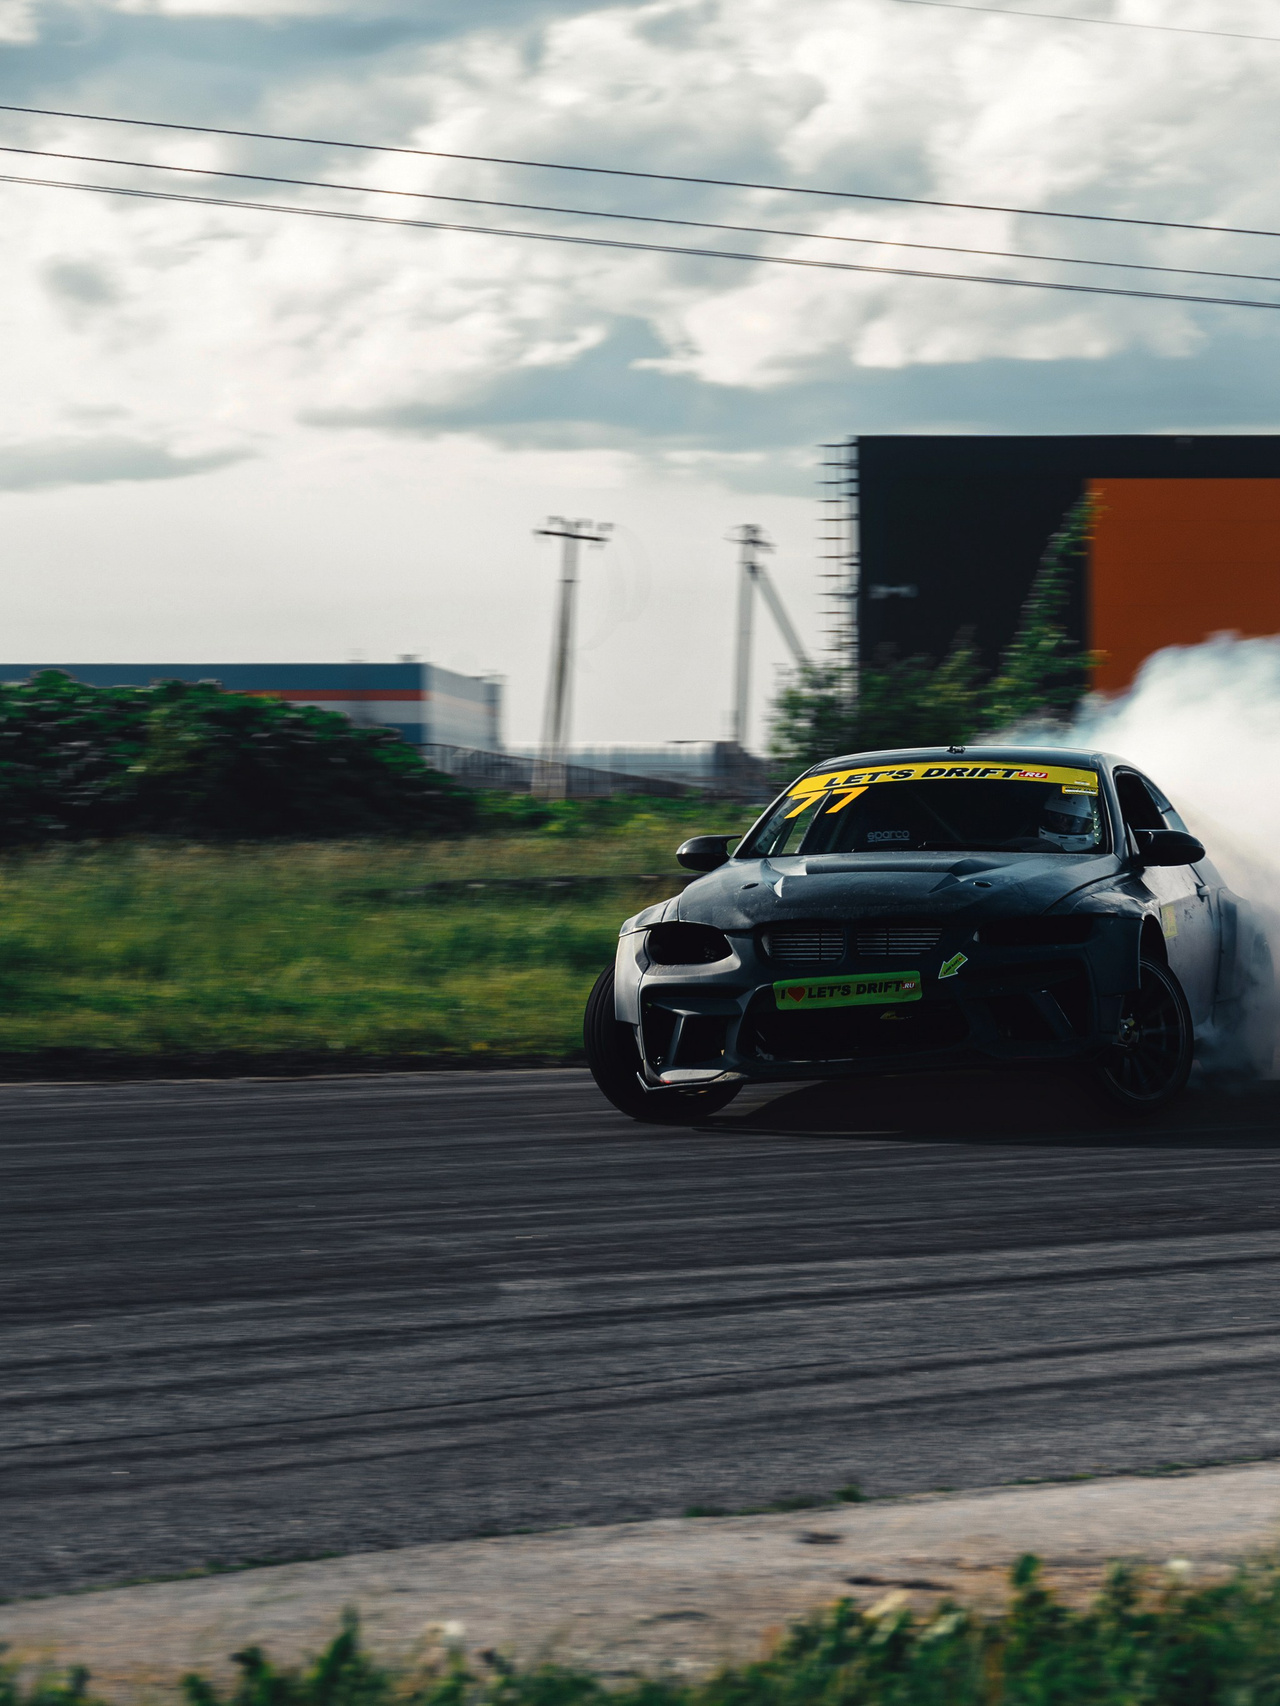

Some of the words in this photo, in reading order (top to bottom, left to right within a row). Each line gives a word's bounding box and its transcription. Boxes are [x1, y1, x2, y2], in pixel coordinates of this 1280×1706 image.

[824, 769, 915, 788] LET'S
[784, 786, 869, 819] 77
[867, 830, 910, 843] sparco
[780, 989, 786, 1000] I
[807, 984, 852, 999] LET'S
